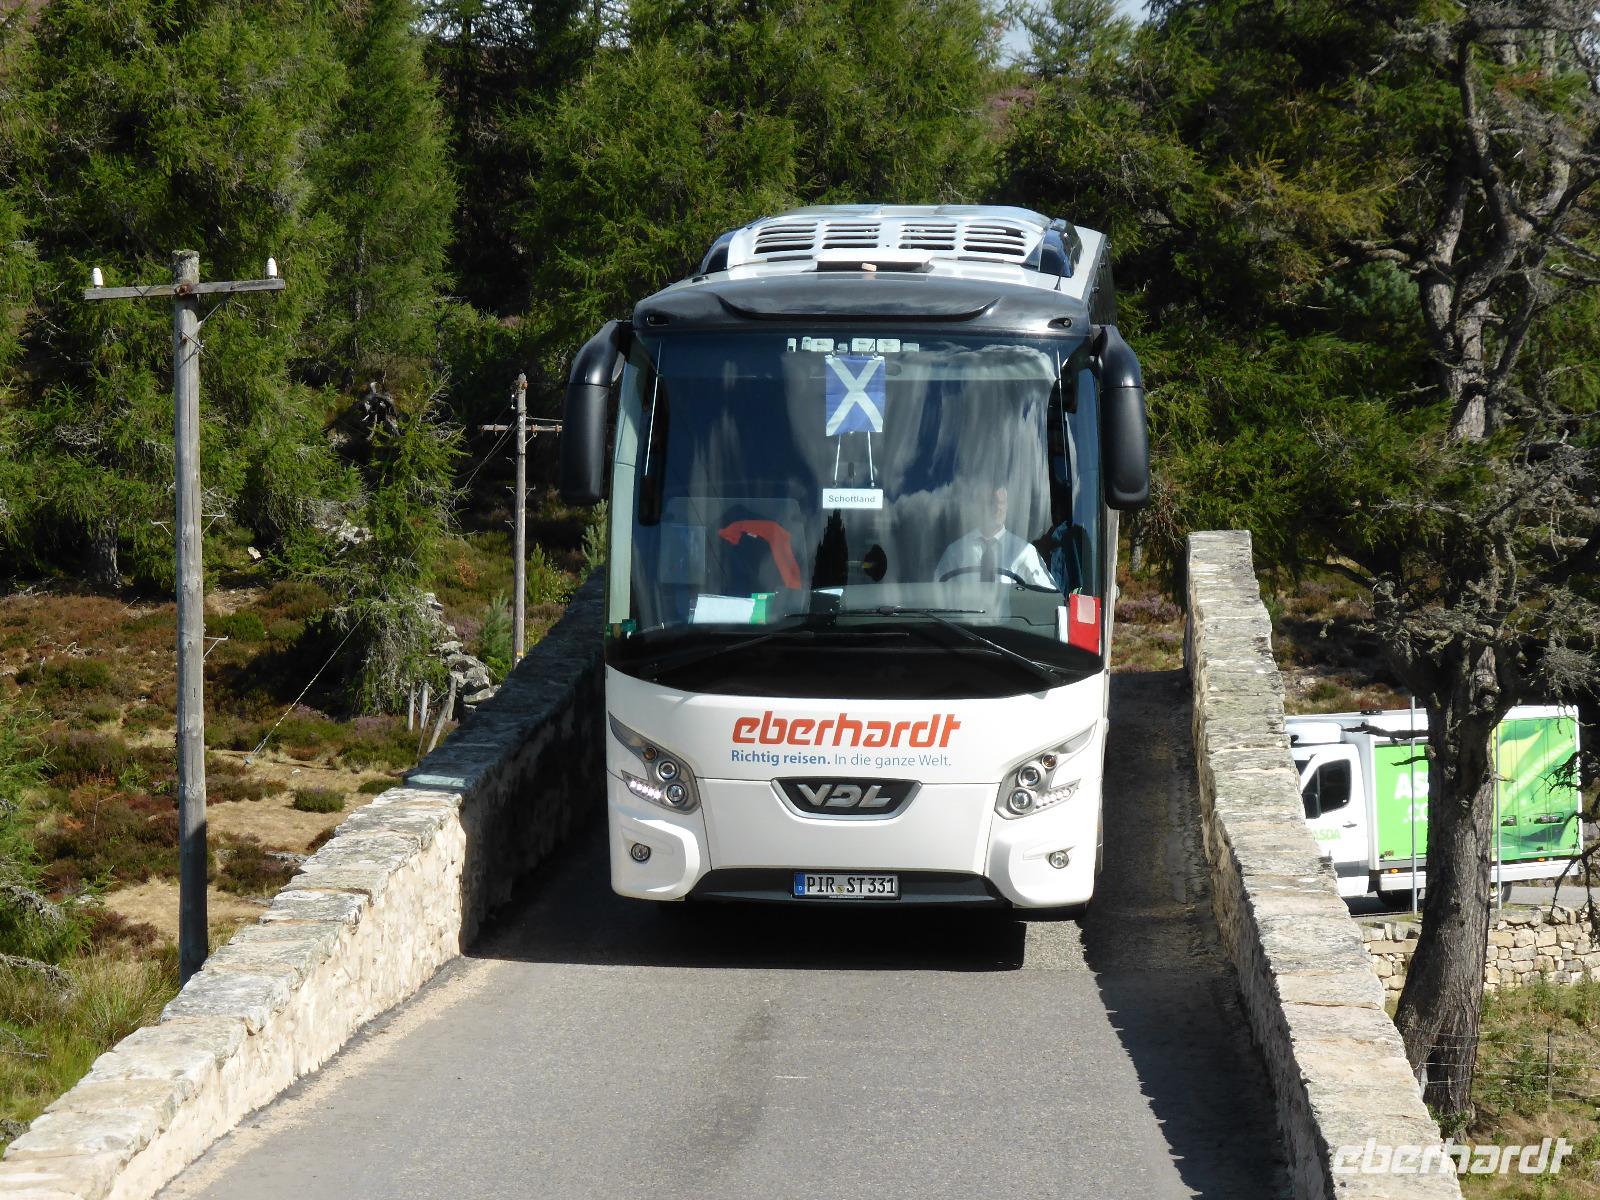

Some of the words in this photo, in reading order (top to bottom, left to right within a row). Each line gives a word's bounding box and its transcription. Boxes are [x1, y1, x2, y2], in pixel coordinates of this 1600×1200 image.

[828, 494, 876, 504] Schottland
[732, 711, 961, 747] eberhardt
[731, 749, 779, 766] Richtig
[783, 753, 831, 765] reisen.
[834, 754, 847, 765] In
[850, 753, 871, 766] die
[875, 756, 915, 769] ganze
[918, 755, 952, 767] Welt.
[797, 784, 892, 808] VDL
[1394, 771, 1429, 800] AS
[806, 876, 835, 893] PIR
